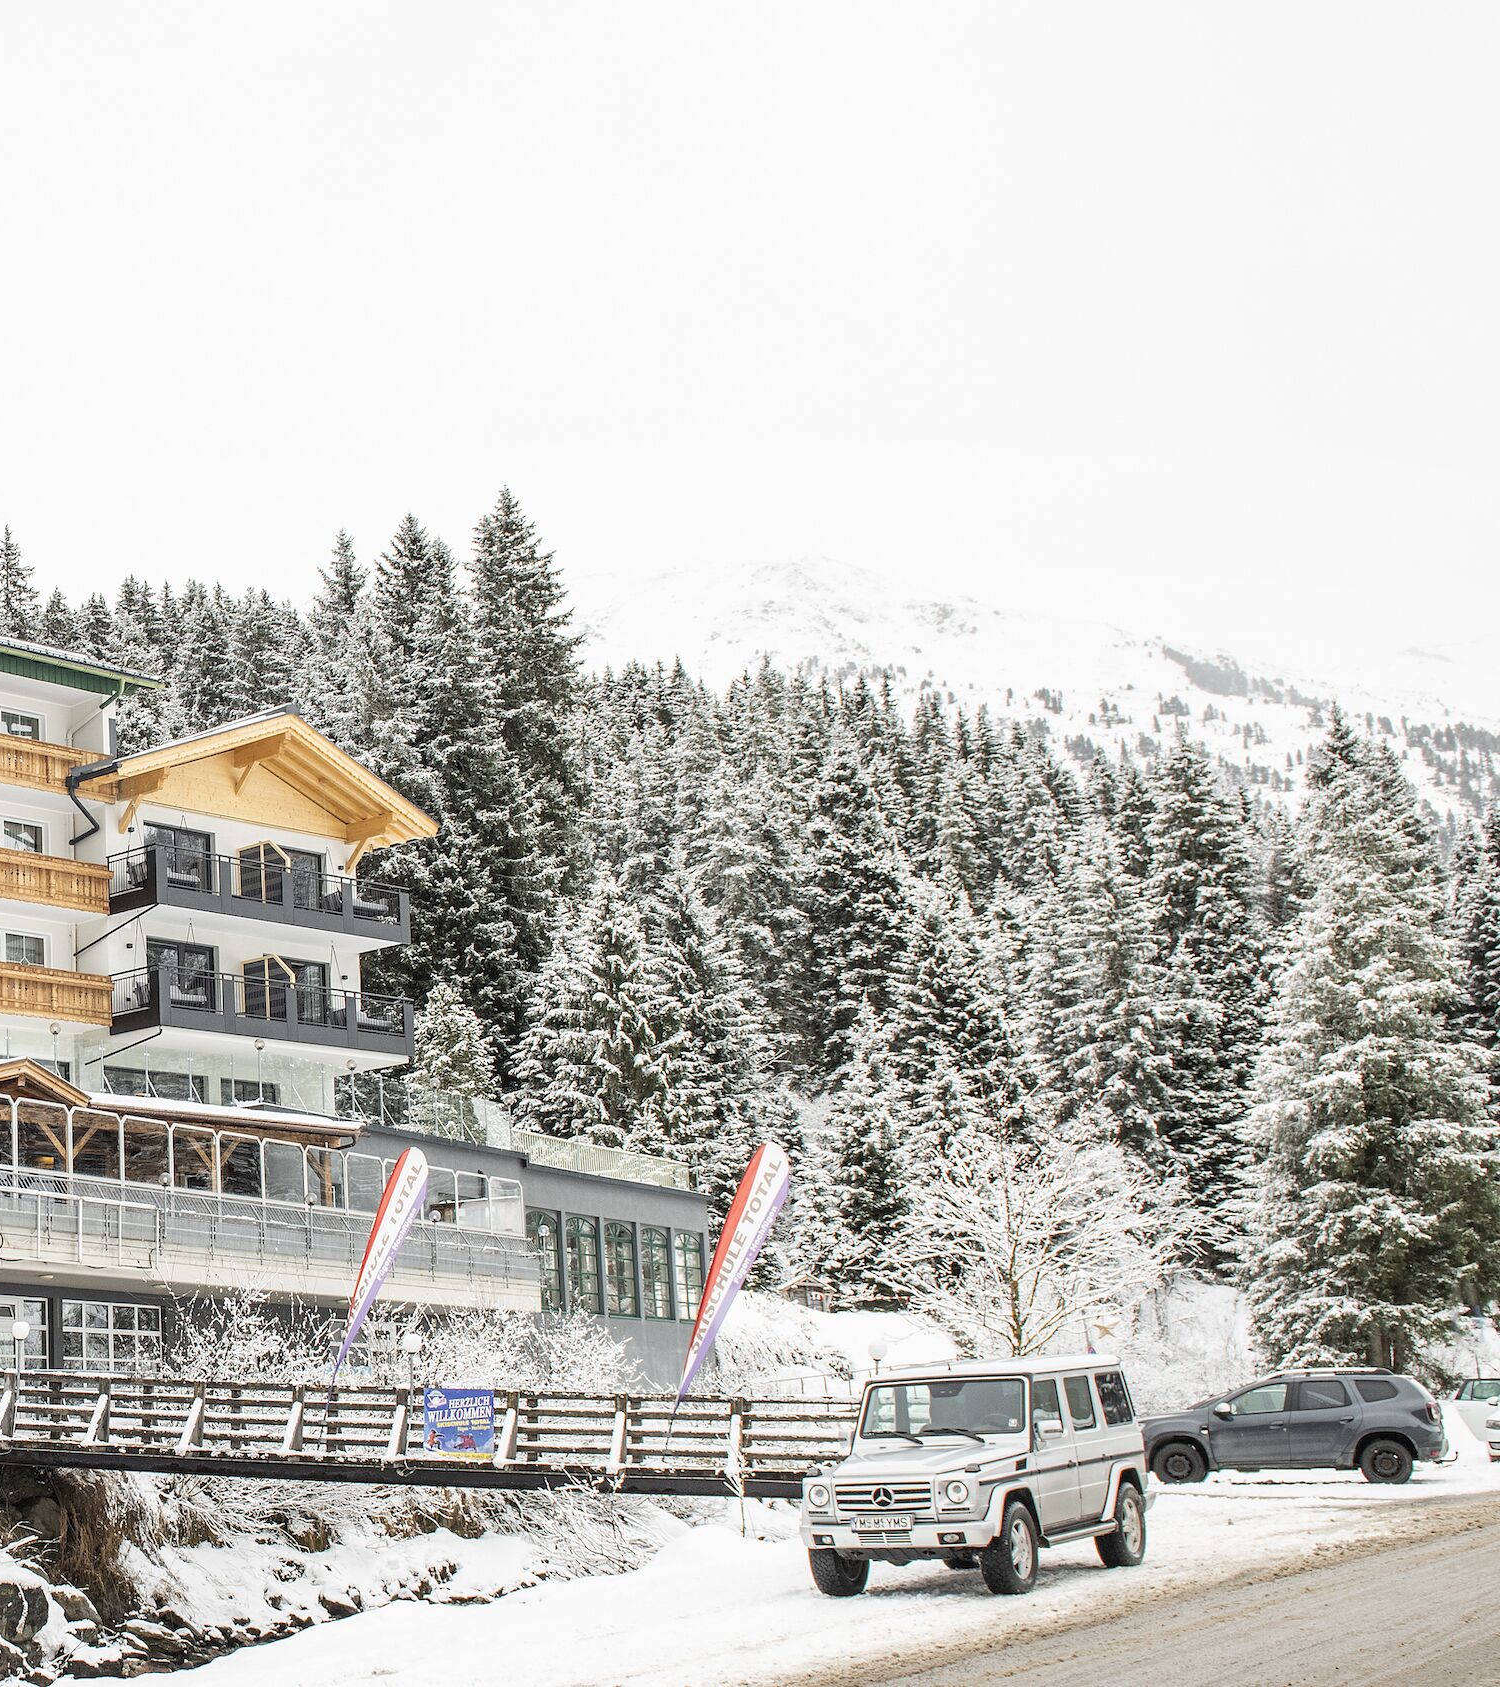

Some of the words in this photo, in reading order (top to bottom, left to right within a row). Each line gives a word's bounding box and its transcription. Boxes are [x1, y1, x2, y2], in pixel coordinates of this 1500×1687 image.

[741, 1159, 782, 1226] TOTAL
[449, 1396, 490, 1409] HERZLICH
[428, 1406, 492, 1422] WILLKOMMEN
